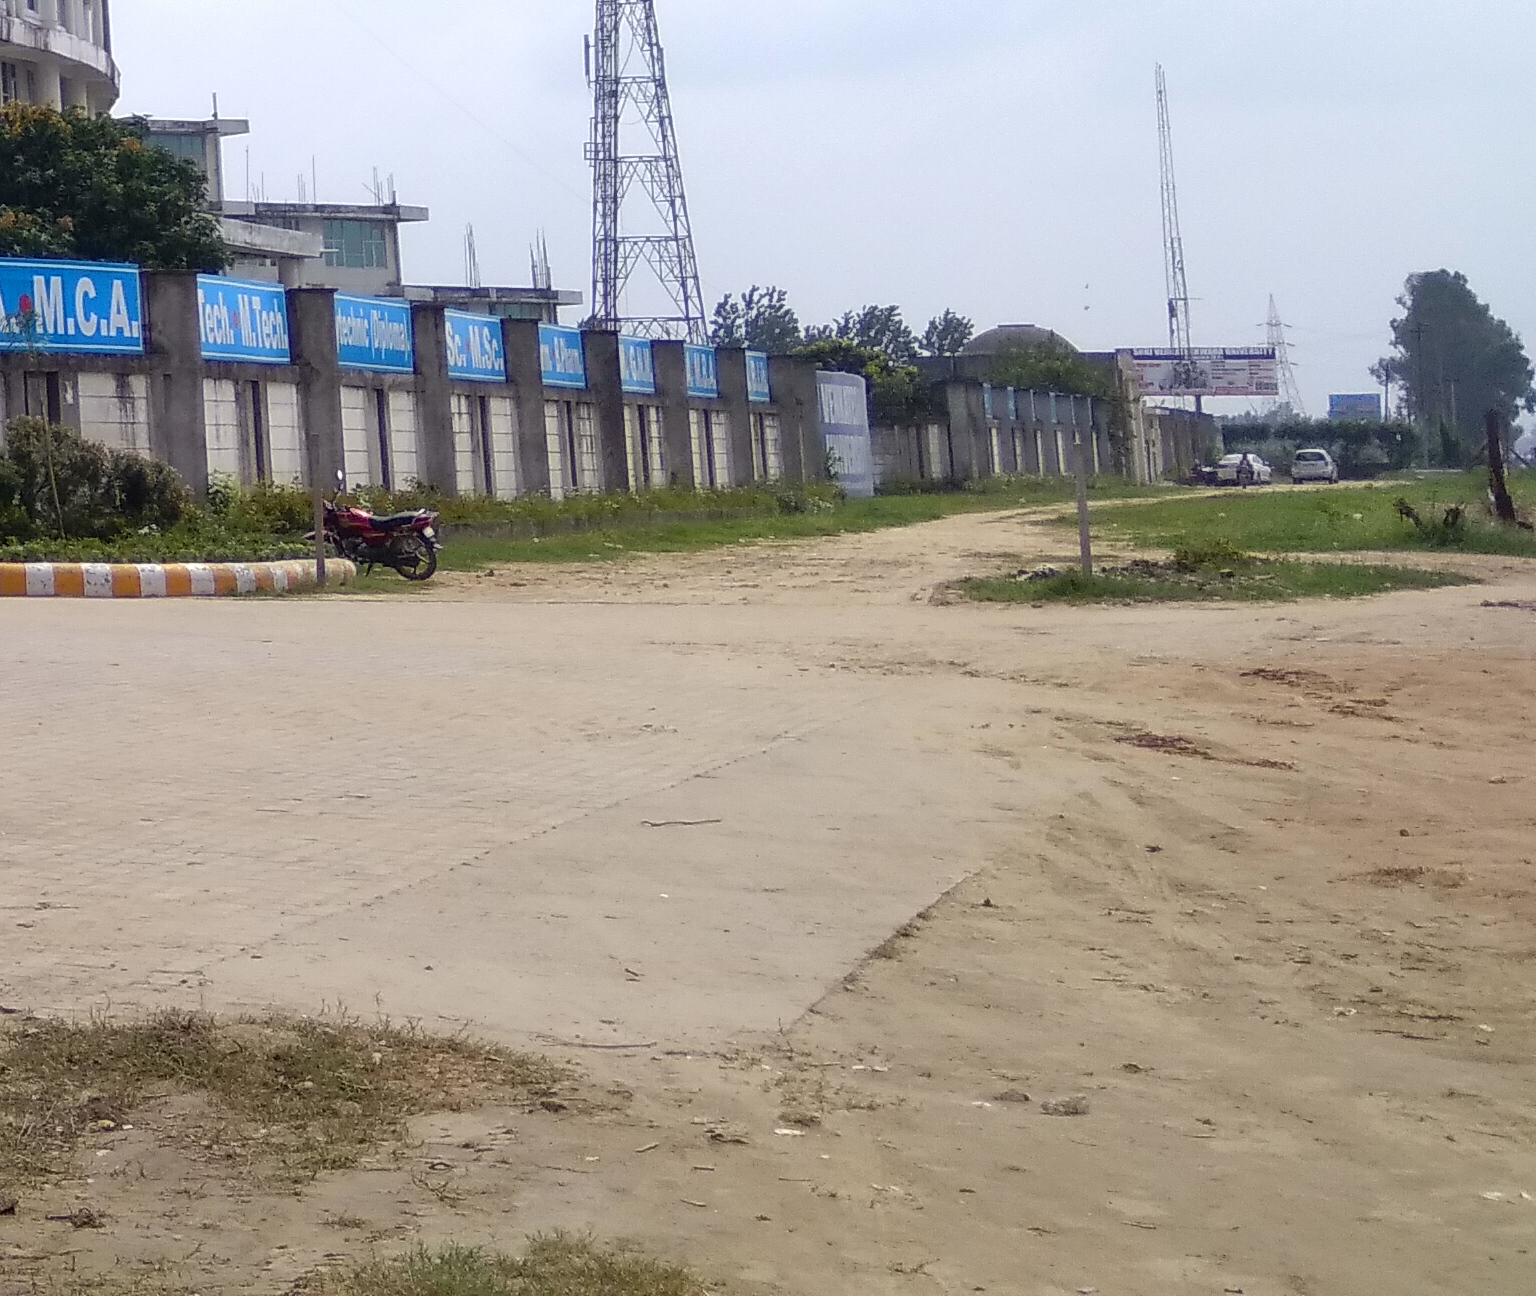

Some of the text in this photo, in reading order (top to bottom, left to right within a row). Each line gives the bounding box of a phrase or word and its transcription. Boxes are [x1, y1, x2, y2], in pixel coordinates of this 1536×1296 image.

[32, 274, 140, 338] M.C.A.
[237, 293, 289, 350] M.Tech.
[468, 323, 504, 371] M.Sc.
